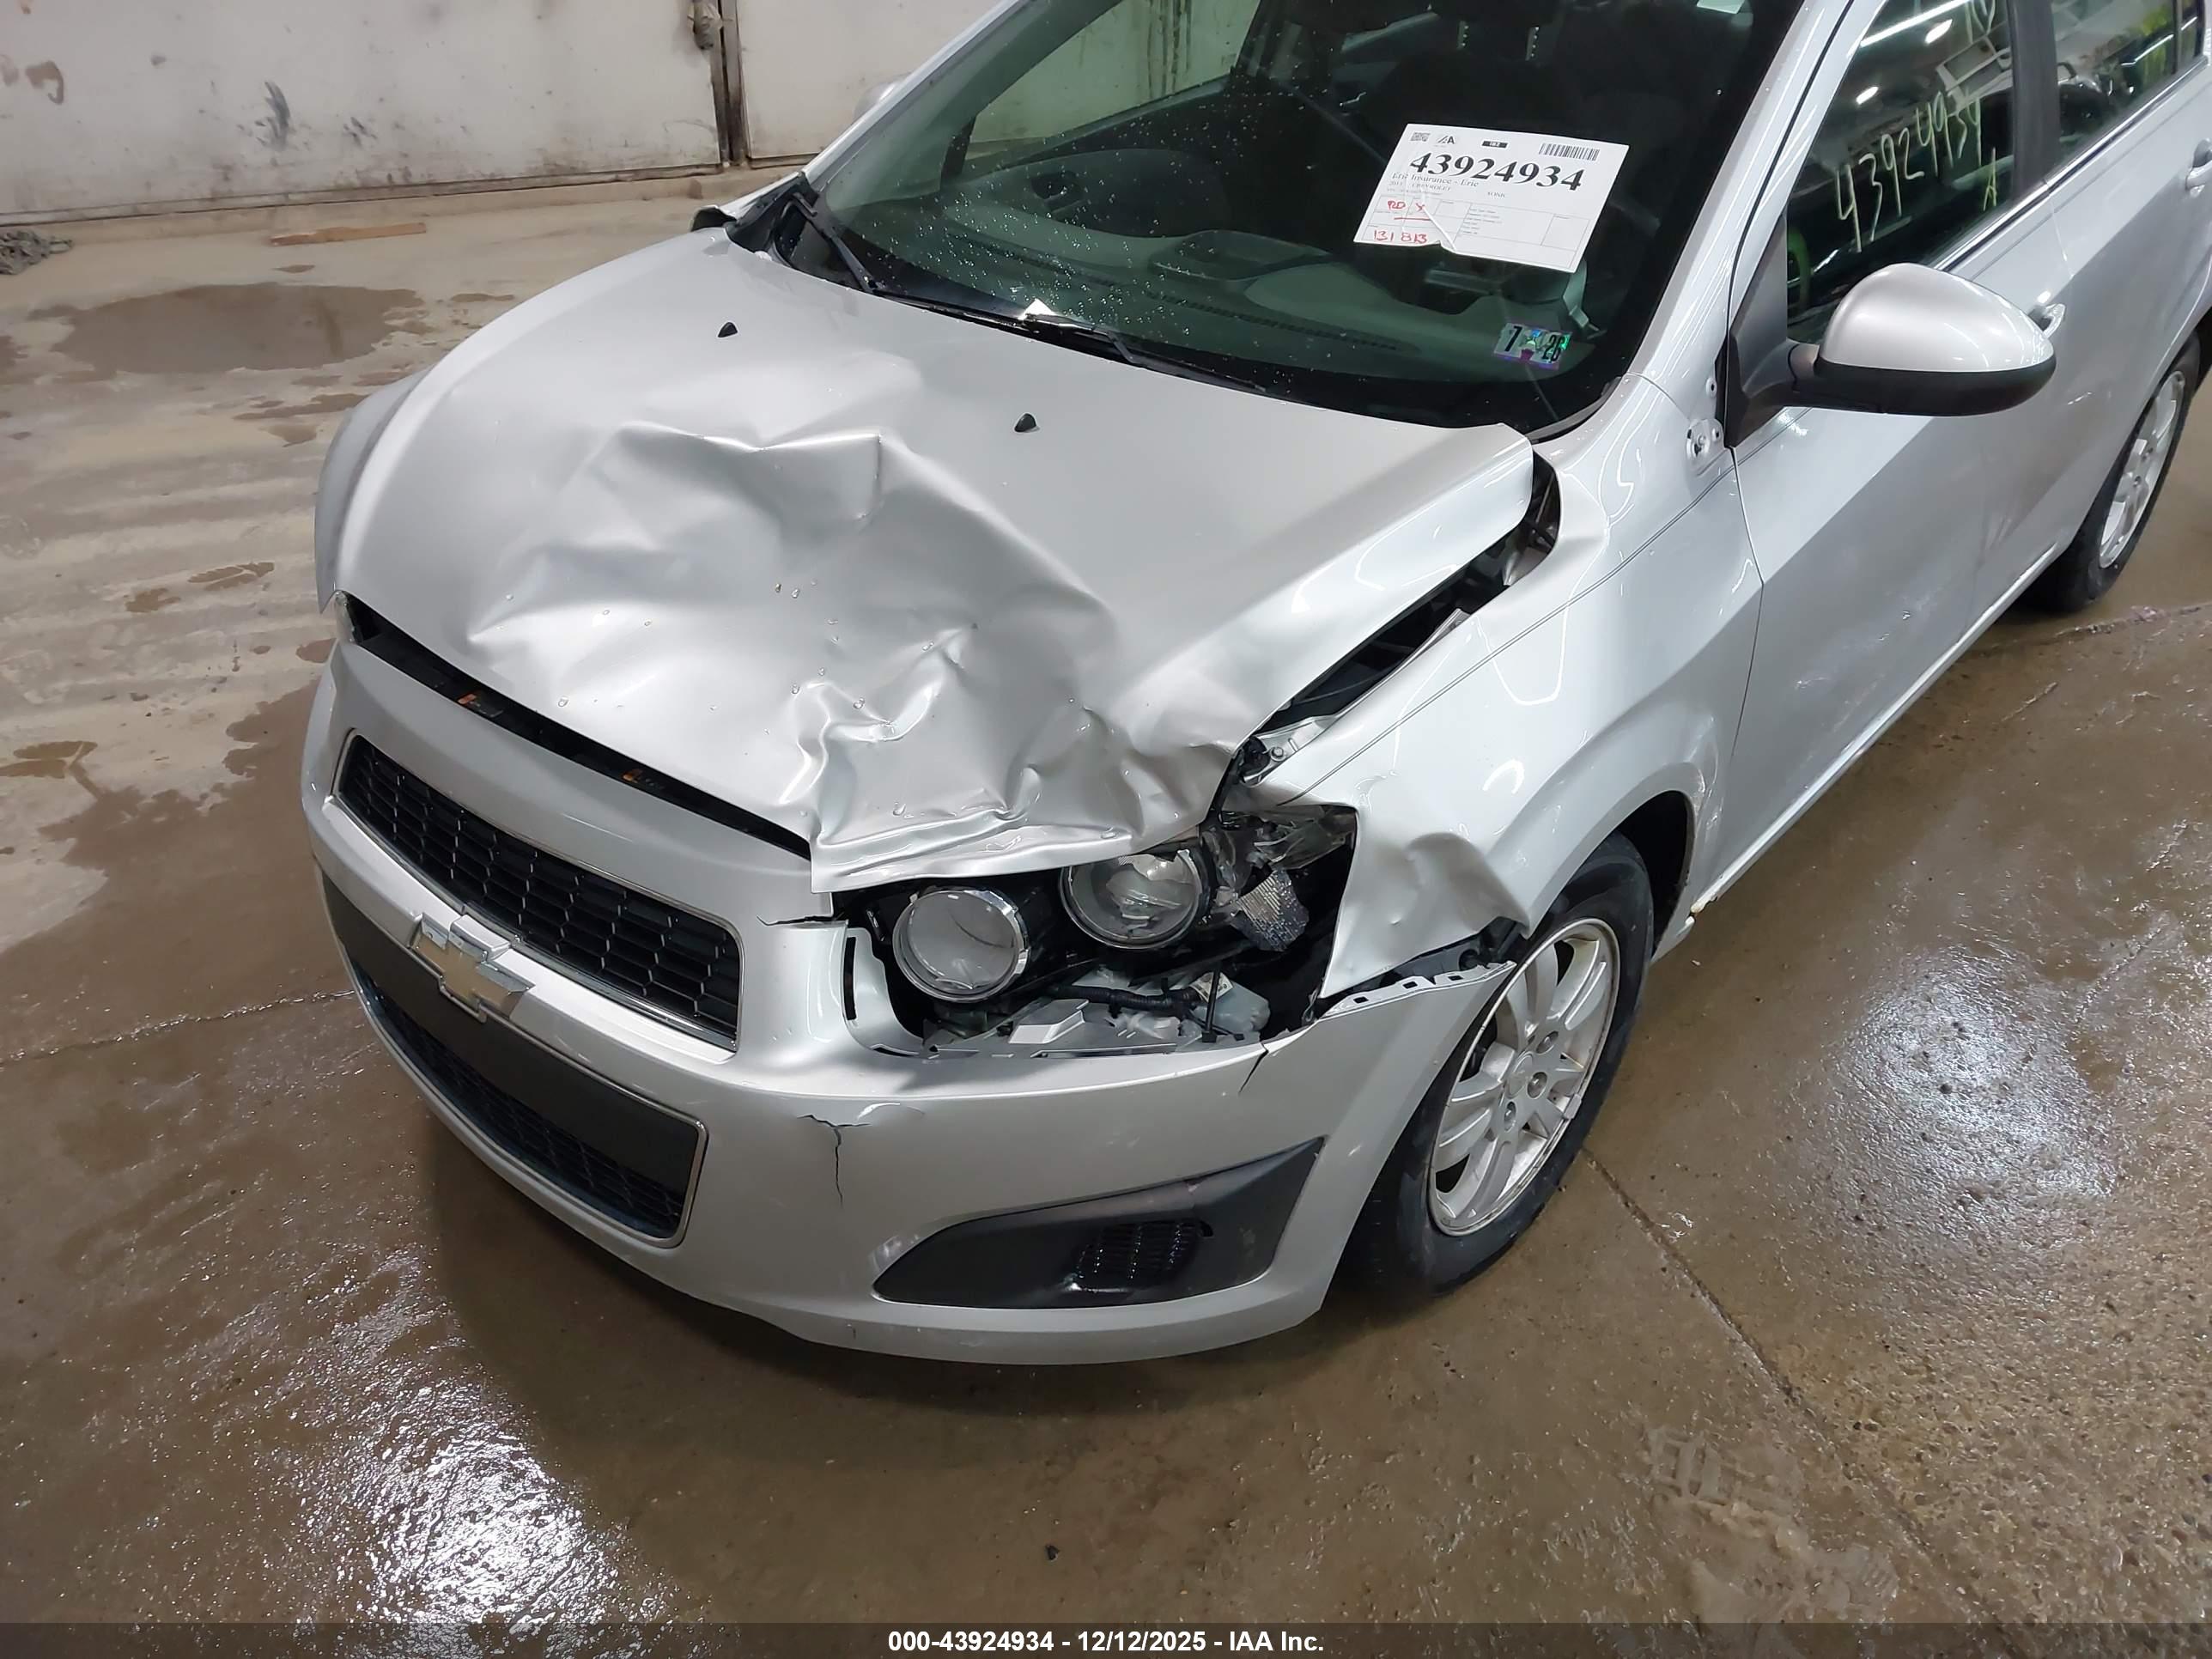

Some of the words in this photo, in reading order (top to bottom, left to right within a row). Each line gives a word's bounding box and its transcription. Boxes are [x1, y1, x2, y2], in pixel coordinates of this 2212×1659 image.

[1409, 151, 1585, 191] 43924934
[1410, 173, 1453, 185] Insurance
[1461, 179, 1480, 188] Erie
[1836, 91, 1982, 252] 43924934
[1504, 325, 1522, 352] 7
